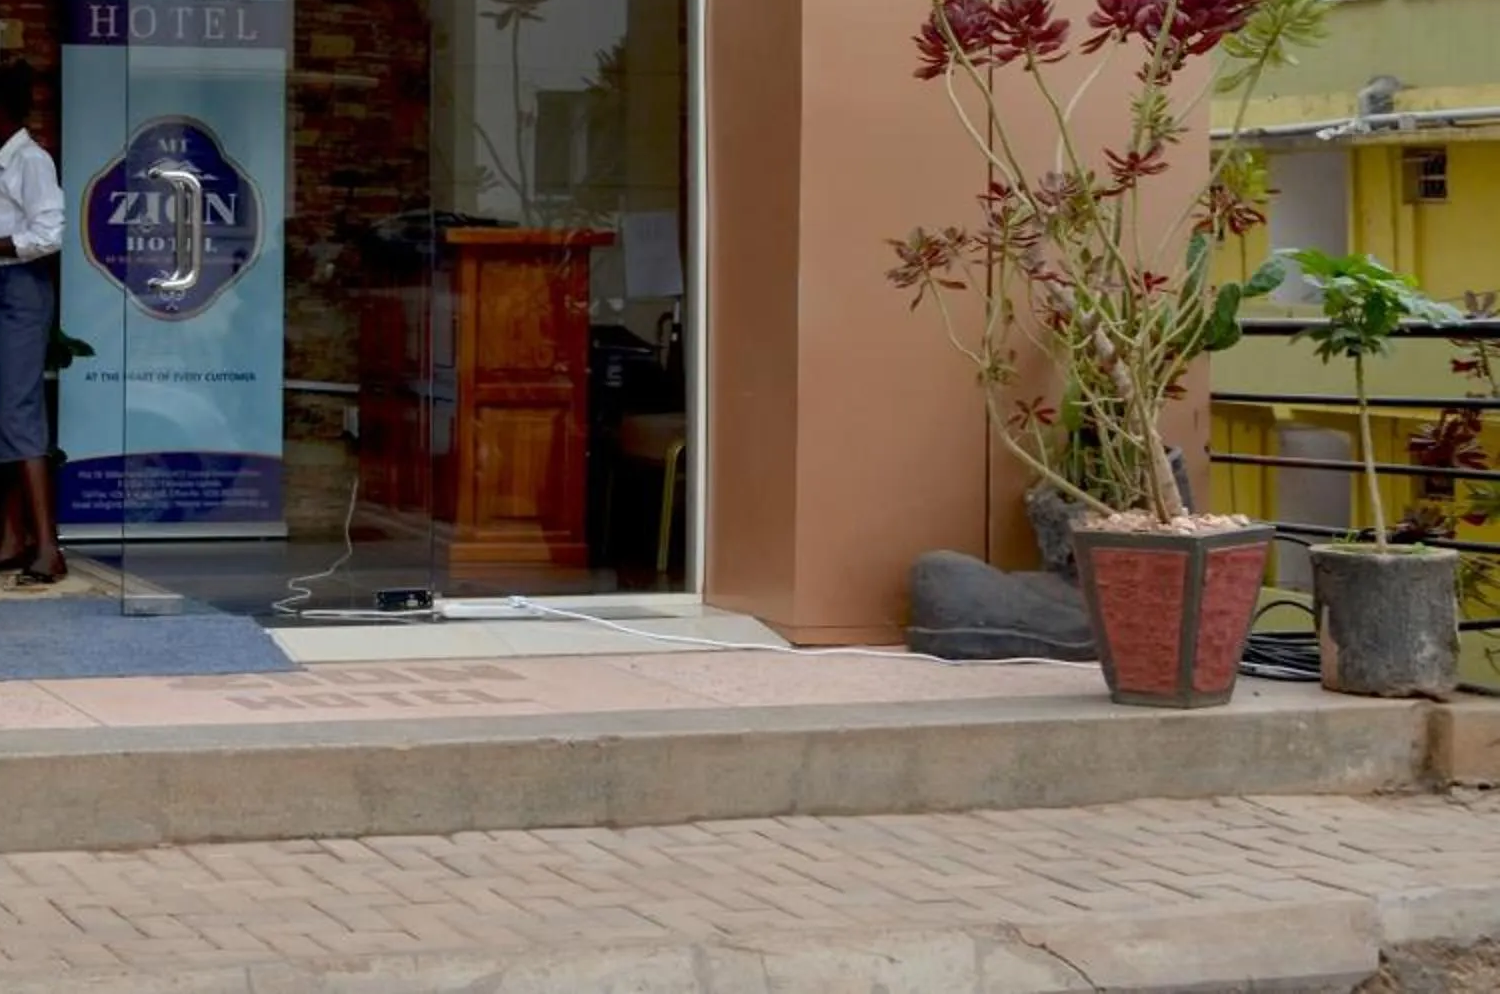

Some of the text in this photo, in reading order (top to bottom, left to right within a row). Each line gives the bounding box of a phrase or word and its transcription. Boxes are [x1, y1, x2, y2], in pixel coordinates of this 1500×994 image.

[88, 4, 258, 40] HOTEL
[158, 139, 192, 153] MT
[223, 688, 537, 710] HOTEL
